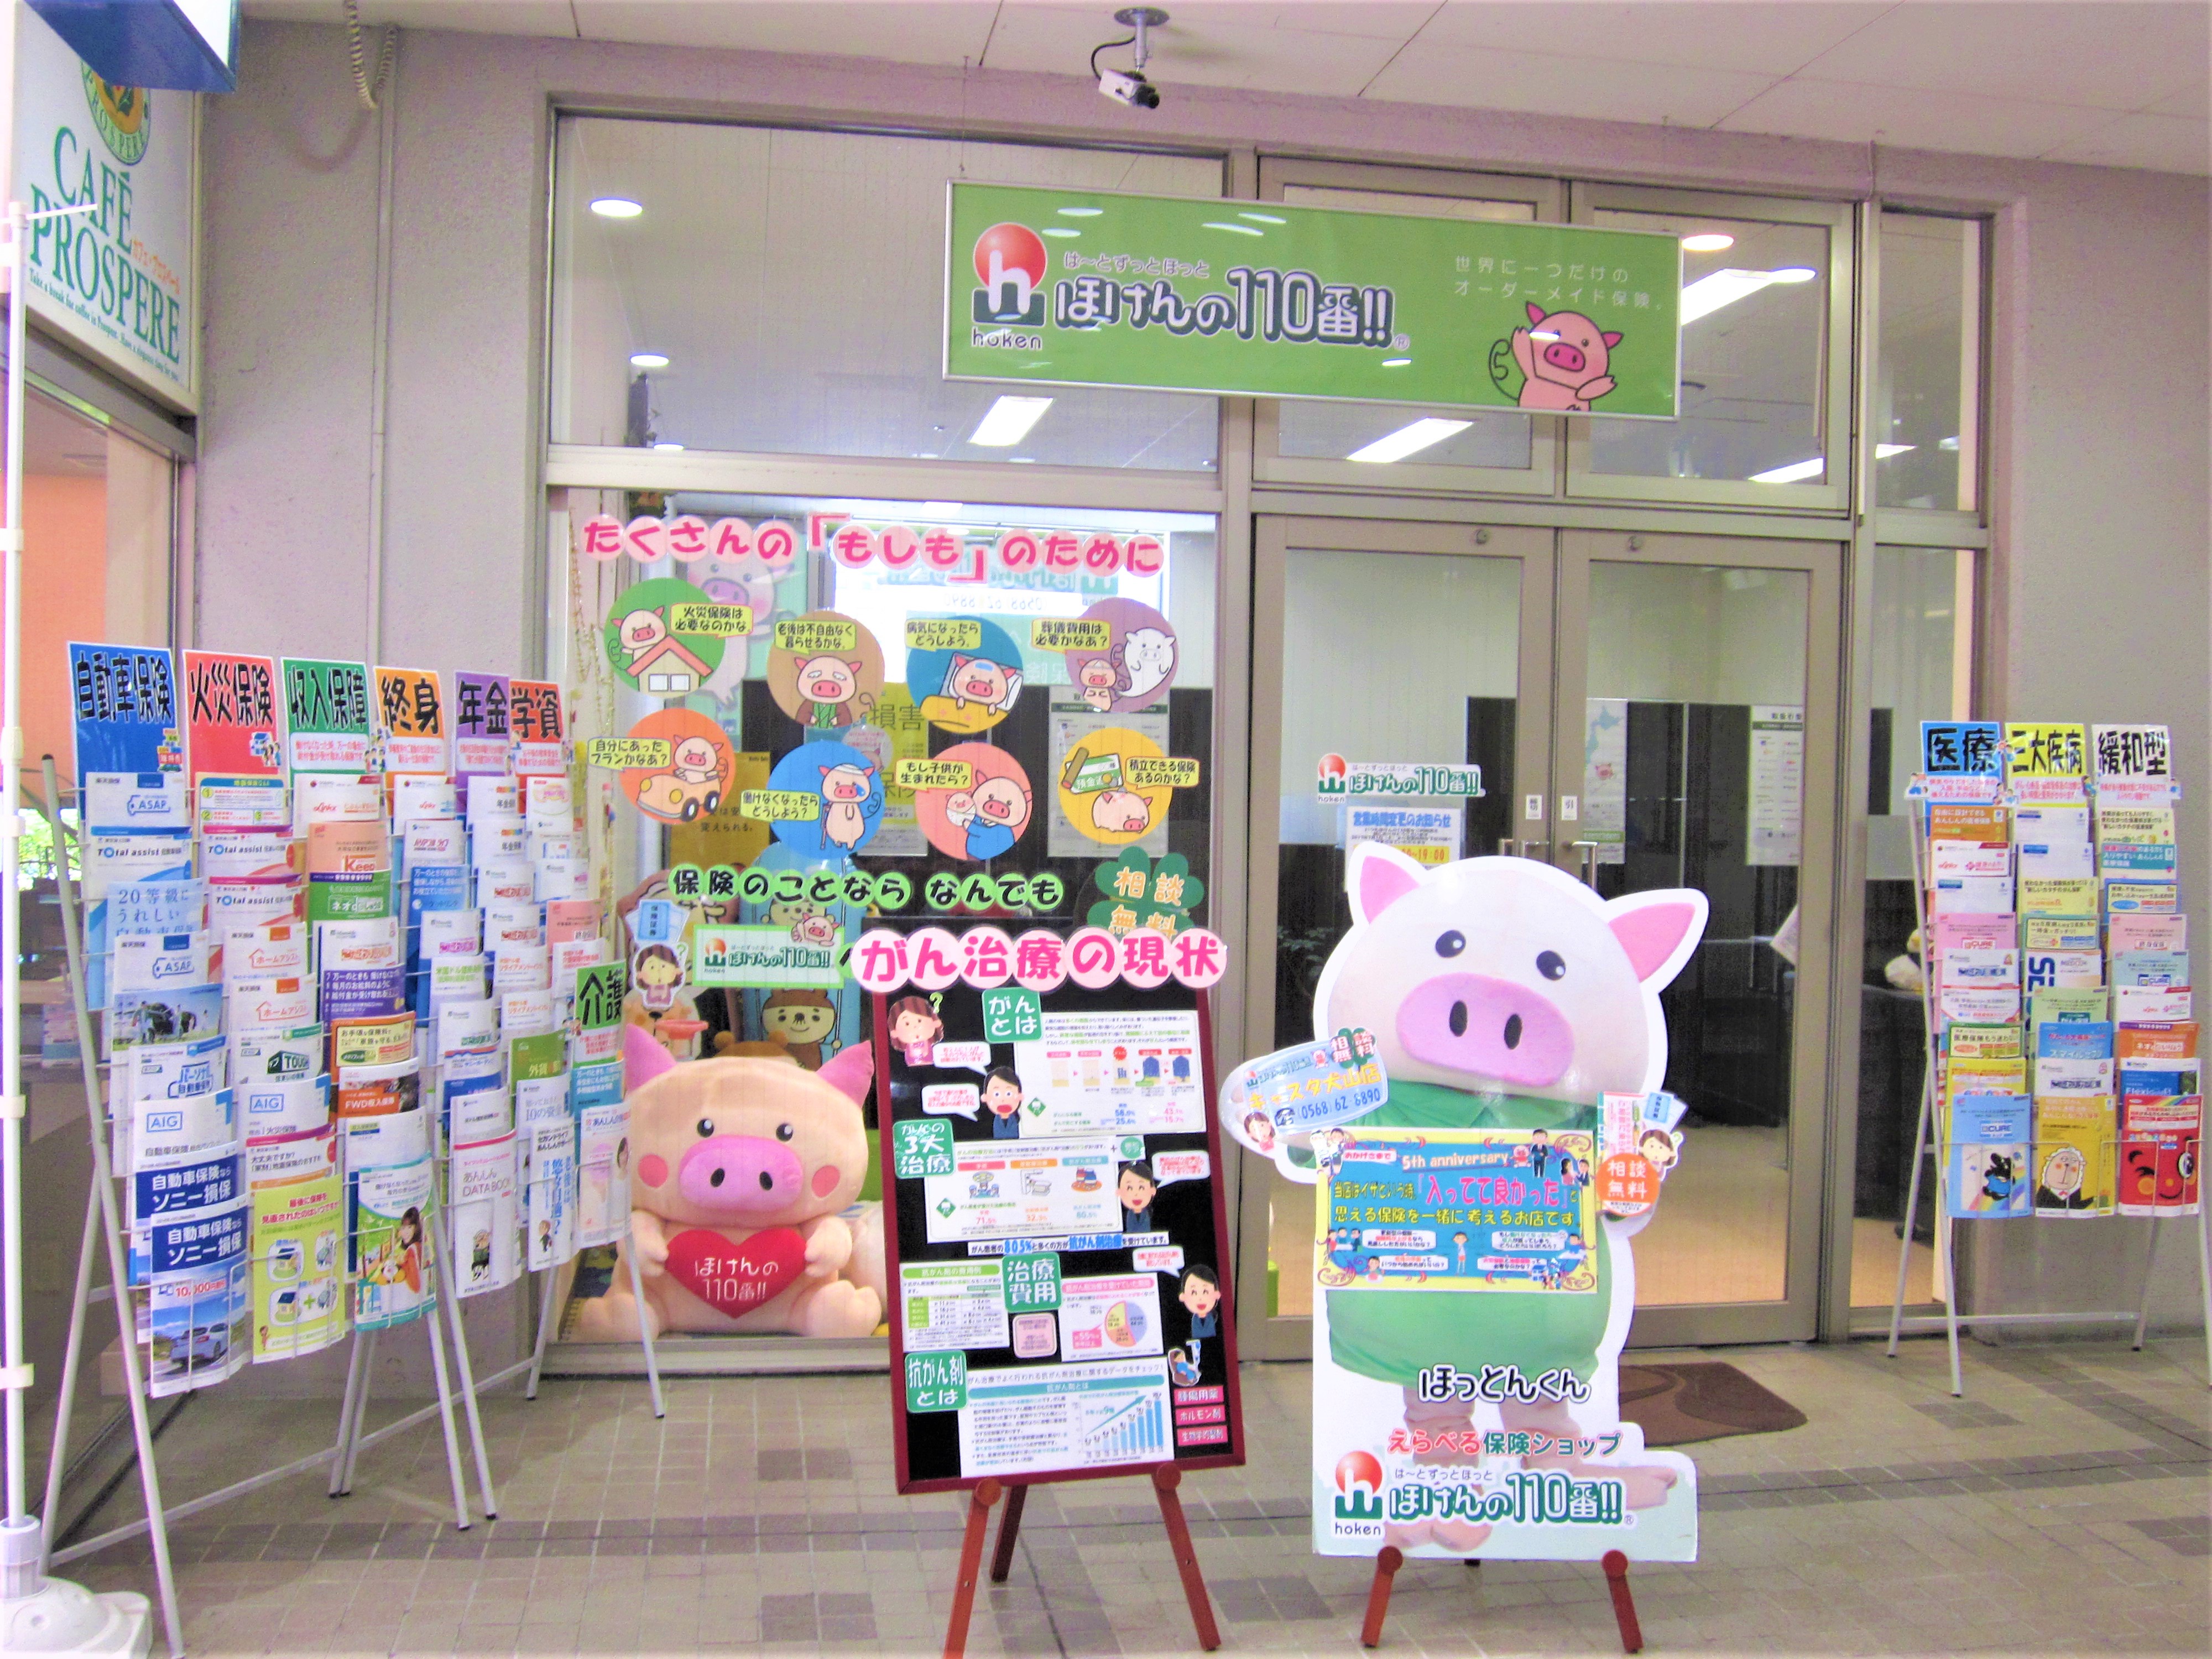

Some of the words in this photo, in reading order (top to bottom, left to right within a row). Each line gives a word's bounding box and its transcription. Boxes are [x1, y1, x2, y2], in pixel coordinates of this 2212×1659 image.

[54, 126, 133, 255] CAFÉ
[30, 183, 180, 364] PROSPERE
[1456, 255, 1629, 283] 世界に一つだけの
[1055, 267, 1395, 348] ほけんの110番!!
[972, 326, 1042, 351] hoken
[584, 513, 1160, 582] たくさんの「もしも」のために
[684, 606, 743, 619] 火災保険は
[778, 622, 853, 636] 老後は不自由なく
[907, 622, 978, 635] 病気になったら
[1041, 622, 1103, 635] 葬儀費用は
[784, 636, 846, 649] 暮らせるかな。
[915, 634, 970, 647] どうしよう。
[1035, 634, 1108, 647] 必要かなあ？
[75, 651, 174, 723] 自動車保険
[190, 659, 275, 725] 火災保険
[288, 665, 369, 733] 収入保障
[380, 676, 441, 735] 終身
[458, 680, 508, 735] 年金
[510, 686, 562, 740] 学資
[596, 739, 662, 752] 自分にあった
[1927, 727, 1997, 773] 医療
[2011, 729, 2083, 774] 三大疾病
[2098, 729, 2168, 776] 緩和型
[591, 753, 667, 766] プランかなあ？
[906, 761, 964, 773] もし子供が
[1129, 759, 1196, 773] 積立できる保険
[900, 772, 968, 785] 生まれたら？
[1134, 771, 1191, 784] あるのかな？
[1349, 766, 1479, 794] ほけんの110番!!
[138, 797, 166, 810] ASAP
[743, 791, 818, 805] 働けなくなったら
[753, 805, 807, 818] どうしよう？
[97, 847, 129, 859] Total
[131, 847, 160, 856] assist
[207, 844, 237, 855] Total
[238, 844, 263, 854] assist
[674, 867, 904, 904] 保険のことなら
[929, 877, 1060, 908] なんでも
[1113, 865, 1184, 907] 相談
[216, 895, 246, 906] Total
[247, 896, 274, 905] assist
[164, 961, 191, 972] ASAP
[861, 934, 1220, 982] がん治療の現状
[578, 968, 624, 1026] 介護
[988, 996, 1036, 1015] がん
[990, 1016, 1037, 1037] とは
[252, 1097, 280, 1110] AIG
[150, 1115, 178, 1130] AIG
[904, 1134, 945, 1154] 3大
[901, 1153, 951, 1175] 治療
[1402, 1157, 1426, 1170] 5th
[1430, 1152, 1509, 1168] anniversary
[1607, 1159, 1646, 1178] 相談
[152, 1165, 232, 1191] 自動車保険なら
[154, 1180, 232, 1208] ソニー損保
[1607, 1181, 1648, 1199] 無料
[168, 1219, 242, 1245] 自動車保険なら
[168, 1232, 242, 1265] ソニー損保
[695, 1257, 779, 1276] ほけんの
[1006, 1259, 1055, 1283] 治療
[702, 1279, 766, 1301] 110番!!
[1009, 1281, 1057, 1306] 費用
[908, 1356, 964, 1389] 抗がん剤
[1420, 1365, 1592, 1402] ほっとんくん
[917, 1387, 959, 1406] とは
[1388, 1428, 1623, 1457] えらべる保険ショップ
[1387, 1472, 1625, 1526] ほけんの110番!!
[1334, 1522, 1381, 1536] hoken
